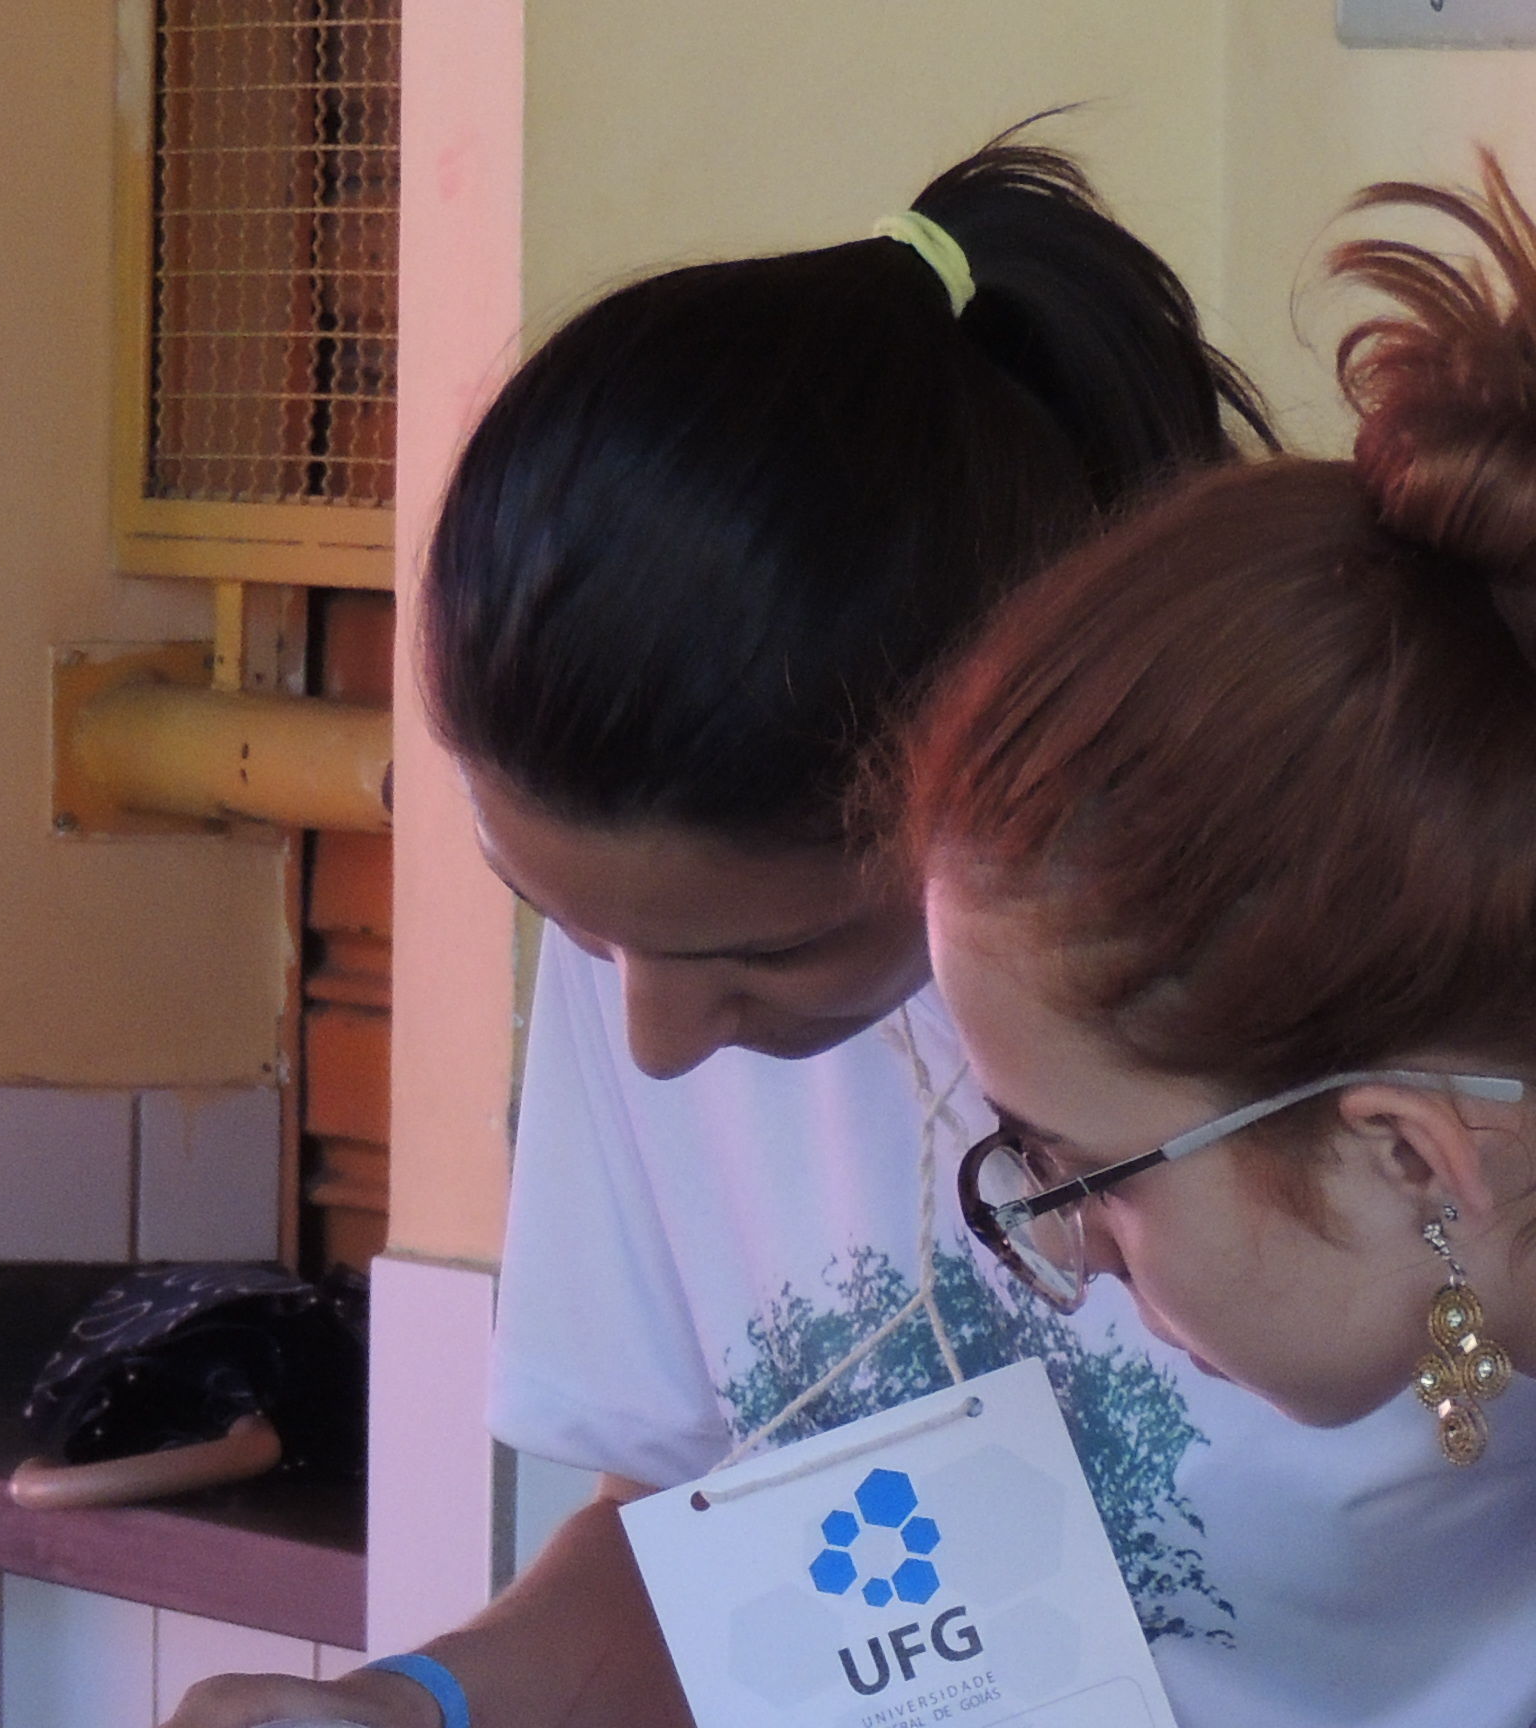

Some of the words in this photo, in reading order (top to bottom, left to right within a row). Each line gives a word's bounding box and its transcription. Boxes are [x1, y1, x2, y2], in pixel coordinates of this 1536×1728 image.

[837, 1605, 984, 1697] UFG
[861, 1671, 997, 1728] UNIVERSIDADE
[933, 1704, 954, 1722] DE
[960, 1687, 1002, 1711] GOIÁS
